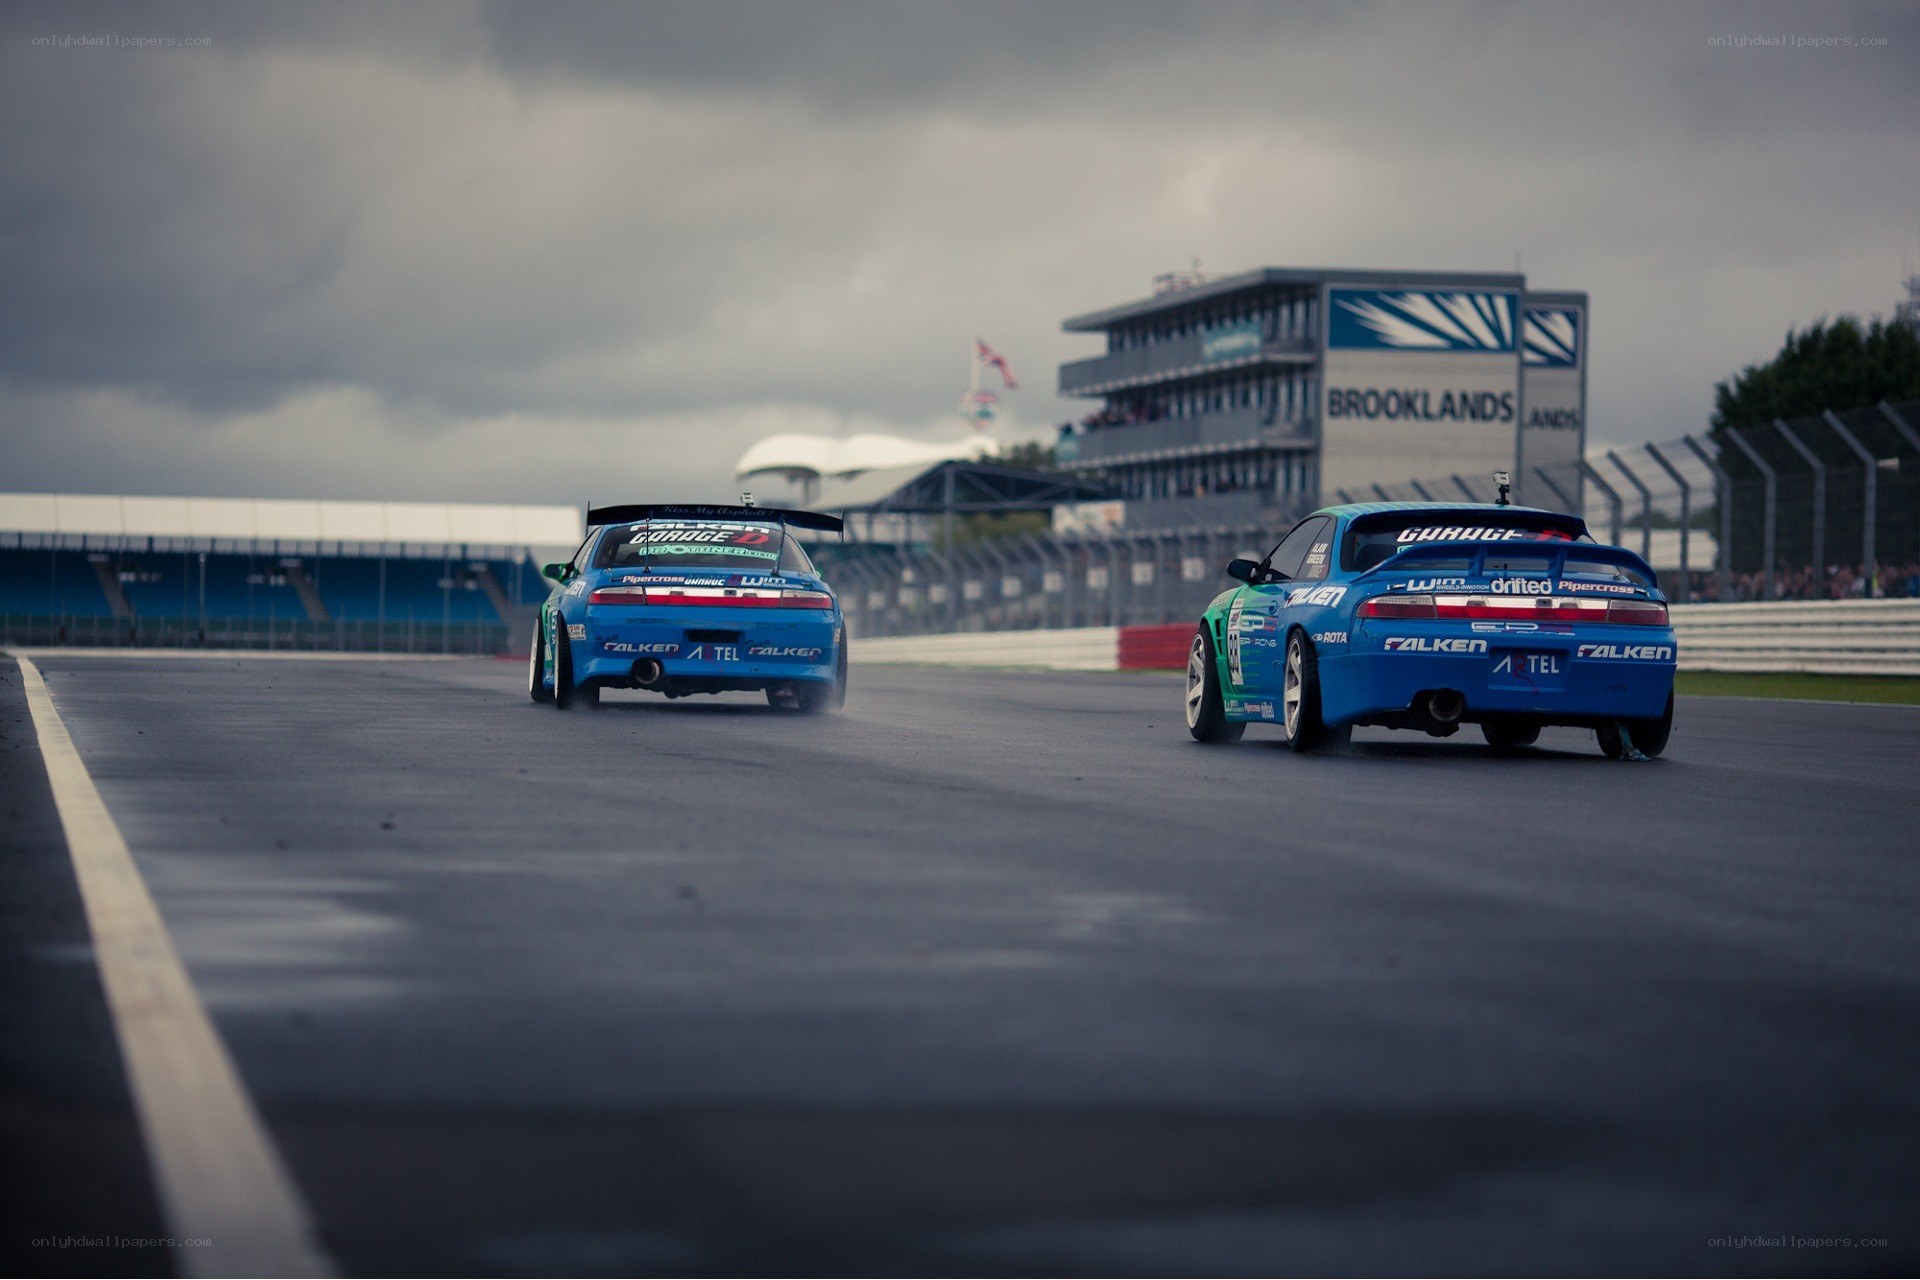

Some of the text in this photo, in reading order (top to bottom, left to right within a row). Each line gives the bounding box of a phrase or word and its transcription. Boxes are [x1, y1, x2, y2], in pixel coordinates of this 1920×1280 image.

[1328, 388, 1514, 423] BROOKLANDS
[691, 507, 714, 516] My
[622, 575, 685, 584] Pipercross
[1490, 577, 1553, 595] drifted
[1558, 580, 1636, 594] Pipercross
[1323, 632, 1348, 643] ROTA
[604, 642, 680, 653] FALKEN
[1384, 637, 1488, 653] FALKEN
[748, 646, 822, 657] FALKEN
[1577, 644, 1672, 660] FALKEN
